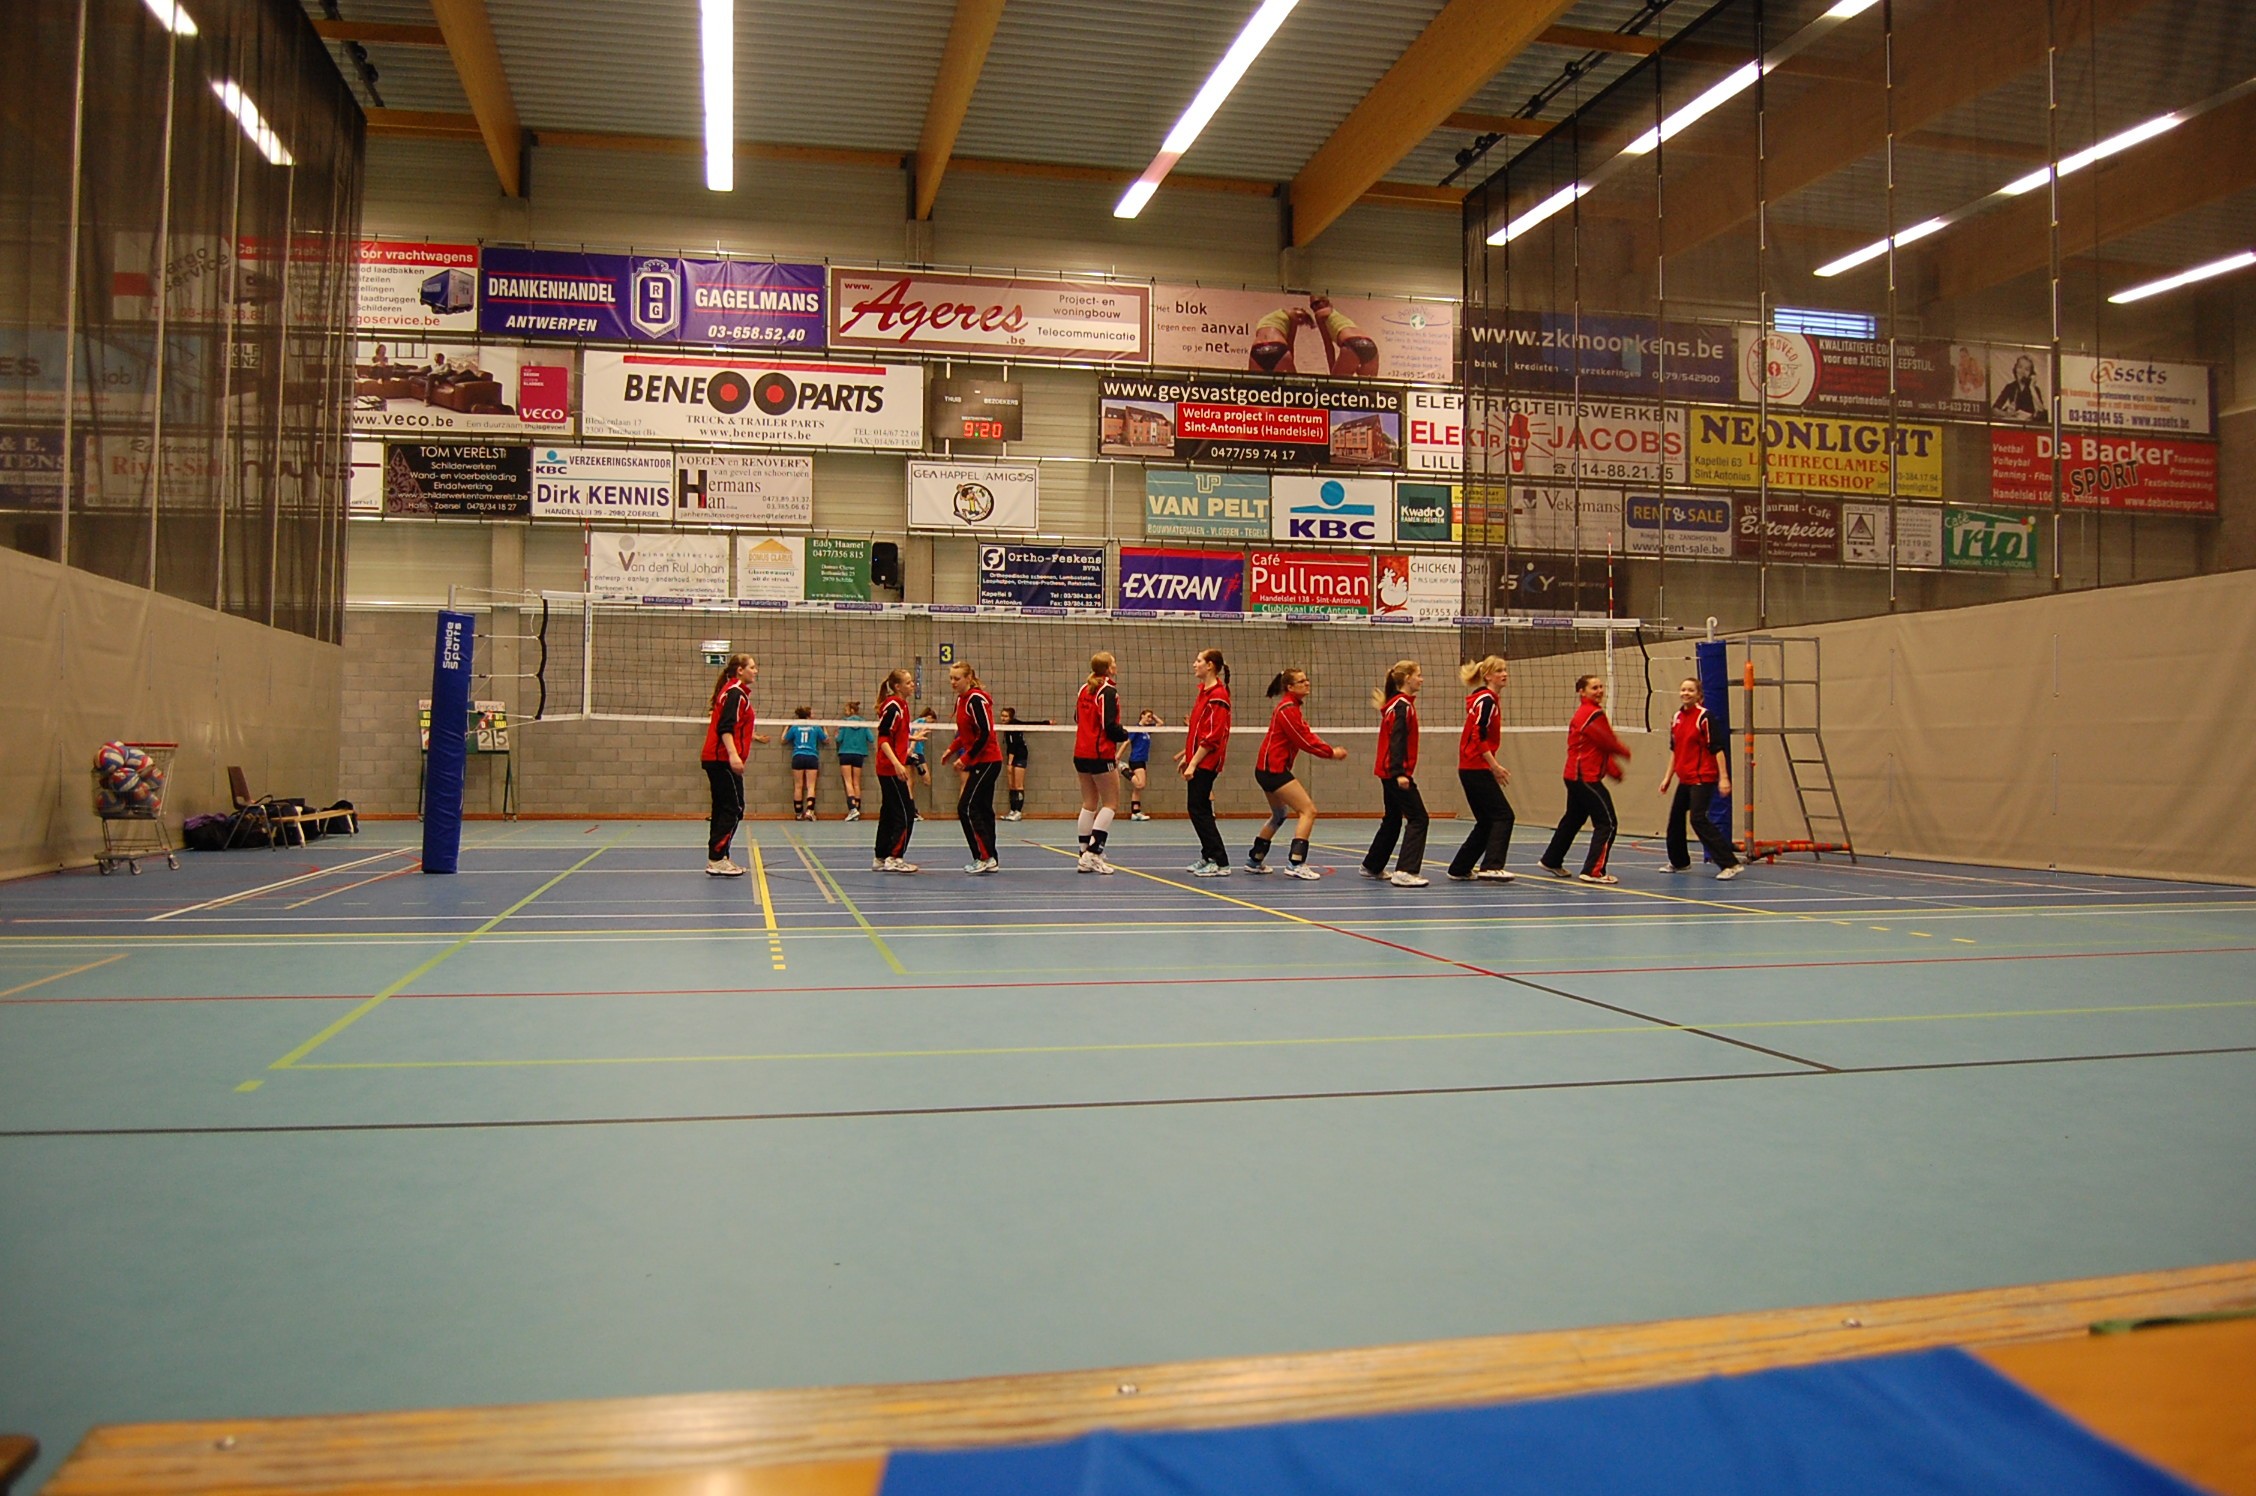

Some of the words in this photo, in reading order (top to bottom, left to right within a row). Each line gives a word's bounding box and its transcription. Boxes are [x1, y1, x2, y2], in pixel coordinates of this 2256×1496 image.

[386, 249, 473, 263] vrachtwagens
[374, 266, 425, 275] laadbakken
[488, 277, 616, 303] DRANKENHANDEL
[844, 282, 873, 291] www.
[360, 295, 416, 306] laadbruggen
[695, 288, 819, 312] GAGELMANS
[1059, 294, 1099, 306] Project-
[839, 277, 1028, 344] Ageres
[1054, 306, 1121, 319] woningbouw
[1175, 301, 1207, 316] blok
[506, 315, 597, 332] ANTWERPEN
[1157, 324, 1180, 333] tegen
[1201, 321, 1250, 335] aanval
[708, 325, 805, 341] 03-658.52.40
[1038, 326, 1137, 341] Telecommunicatie
[1006, 335, 1026, 346] .be
[1471, 326, 1724, 360] www.zkmoorkens.be
[1819, 339, 1875, 352] KWALITATIEVE
[1474, 359, 1498, 369] bank
[1514, 361, 1559, 372] kredieten
[1823, 356, 1841, 364] voor
[1842, 357, 1858, 365] een
[624, 374, 707, 405] BENE
[797, 382, 884, 413] PARTS
[1104, 381, 1398, 410] www.geysvastgoedprojecten.be
[983, 398, 1019, 406] BEZOEKERS
[1938, 401, 1961, 412] 03-633
[1963, 403, 1972, 412] 22
[1973, 403, 1980, 413] 11
[522, 408, 564, 420] VECO
[1183, 407, 1221, 419] Weldra
[1223, 410, 1263, 422] project
[1265, 411, 1275, 421] in
[1278, 413, 1323, 424] centrum
[1416, 395, 1678, 423] ELEKTRICITEITSWERKEN
[467, 420, 482, 428] Een
[483, 421, 522, 429] duurzaam
[686, 414, 725, 425] TRUCK
[727, 416, 735, 425] &
[738, 417, 789, 427] TRAILER
[791, 419, 825, 428] PARTS
[2069, 409, 2098, 423] 03-633
[2101, 411, 2110, 423] 44
[2113, 412, 2123, 425] 55
[2131, 415, 2189, 429] www.assets.be
[699, 427, 812, 441] www.beneparts.be
[1184, 421, 1258, 435] Sint-Antonius
[1260, 425, 1324, 439] (Handelslei)
[1700, 415, 1934, 457] NEONLIGHT
[1547, 426, 1682, 455] JACOBS
[420, 446, 450, 458] TOM
[453, 447, 504, 459] VERELST
[1211, 447, 1260, 460] 0477/59
[1263, 449, 1277, 460] 74
[1281, 450, 1296, 460] 17
[1992, 444, 2024, 454] Voetbal
[2036, 436, 2072, 460] De
[2081, 439, 2173, 465] Backer
[431, 461, 497, 470] Schilderwerken
[536, 466, 567, 474] KBC
[569, 456, 671, 468] VERZEKERINGSKANTOOR
[680, 456, 726, 466] VOEGEN
[741, 457, 809, 468] RENOVEREN
[1695, 455, 1729, 468] Kapellei
[1731, 457, 1742, 467] 63
[1748, 452, 1889, 474] LCHTRECLAMES
[1992, 456, 2031, 467] Volleybal
[453, 473, 517, 482] vloerbekleding
[729, 469, 752, 478] gevel
[913, 469, 938, 479] GEA
[940, 471, 980, 480] HAPPEL
[985, 472, 1034, 482] AMIGOS
[1695, 469, 1712, 479] Sint
[1714, 470, 1751, 481] Antonius
[1992, 470, 2026, 481] Running
[2070, 461, 2140, 496] SPORT
[2169, 468, 2213, 478] Promowear
[433, 482, 493, 491] Eindafwerking
[1765, 471, 1874, 489] LETTERSHOP
[2144, 478, 2213, 489] Textielbedrukking
[537, 484, 581, 504] Dirk
[588, 485, 670, 507] KENNIS
[1992, 489, 2036, 501] Handelslei
[466, 503, 496, 511] 0478/34
[1148, 495, 1198, 516] VAN
[1207, 497, 1269, 518] PELT
[2125, 497, 2215, 511] www.debackersport.be
[1633, 505, 1671, 520] RENT
[1672, 506, 1686, 522] &
[1688, 508, 1724, 523] SALE
[1808, 505, 1831, 520] Café
[1944, 512, 1970, 528] Café
[1147, 524, 1204, 535] BOUWMATERIALEN
[1210, 527, 1239, 537] VLOEREN
[1244, 527, 1268, 537] TEGELS
[1289, 518, 1375, 539] KBC
[813, 540, 832, 548] Eddy
[835, 540, 864, 549] Haamel
[1679, 534, 1717, 542] ZANDHOVEN
[813, 550, 848, 558] 0477/356
[849, 551, 863, 559] 815
[1008, 553, 1101, 564] Ortho-Feskens
[1252, 553, 1280, 566] Café
[619, 551, 648, 572] Van
[649, 562, 669, 572] den
[673, 562, 688, 573] Rul
[692, 563, 724, 574] Johan
[1411, 562, 1456, 573] CHICKEN
[1122, 573, 1223, 602] EXTRAN
[1251, 566, 1369, 596] Pullman
[1259, 595, 1296, 604] Handelslei
[1298, 595, 1310, 604] 138
[1316, 596, 1361, 605] Sint-Antonius
[1261, 603, 1308, 614] Clublokaal
[1309, 605, 1324, 614] KFC
[1420, 608, 1451, 617] 03/353
[451, 623, 462, 669] Sports
[941, 645, 952, 662] 3
